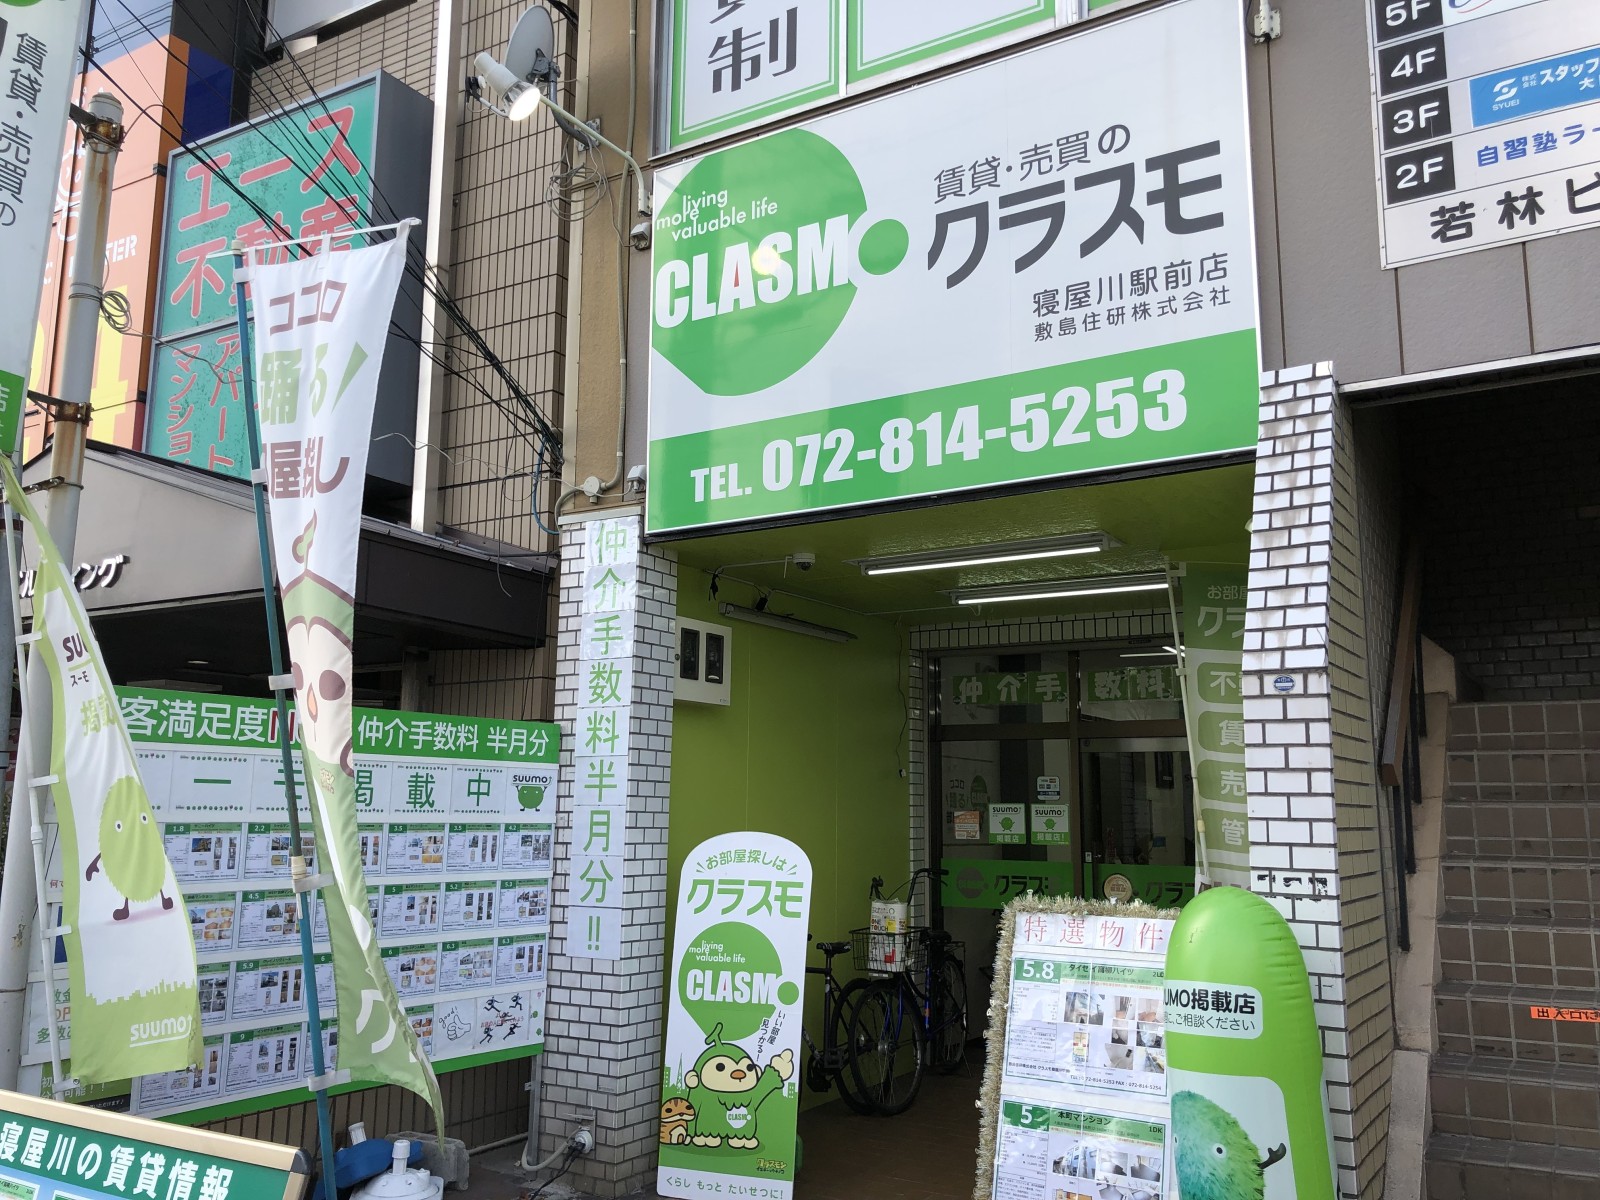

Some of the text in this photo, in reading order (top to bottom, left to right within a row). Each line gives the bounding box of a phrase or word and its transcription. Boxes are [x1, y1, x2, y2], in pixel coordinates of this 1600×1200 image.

[1390, 47, 1436, 78] 4F
[1393, 101, 1440, 134] 3F
[1492, 98, 1520, 111] SYUEI
[934, 124, 1132, 204] 賃貸・売買の
[1395, 156, 1444, 189] 2F
[672, 196, 778, 242] valuable life
[683, 189, 728, 223] living
[927, 140, 1225, 290] クラスモ
[1033, 252, 1230, 319] 寝屋川駅前店
[269, 279, 348, 336] ココロ
[1034, 285, 1232, 342] 敷島住研株式会社
[166, 343, 202, 465] マンショ
[691, 368, 1188, 503] TEL. 072-814-5253
[357, 715, 550, 757] 仲介手数料 半月分
[254, 824, 266, 832] 2.2
[705, 849, 788, 872] お部屋探しは
[686, 878, 805, 919] クラスモ
[701, 940, 724, 952] living
[1024, 915, 1164, 951] 特選物件
[695, 953, 746, 964] valuable life
[1022, 960, 1055, 979] 5.8
[1537, 1007, 1600, 1020] 出入口に
[1020, 1105, 1033, 1124] 5
[1148, 1126, 1163, 1134] 1DK
[666, 1175, 691, 1188] くらし
[696, 1179, 722, 1193] もっと
